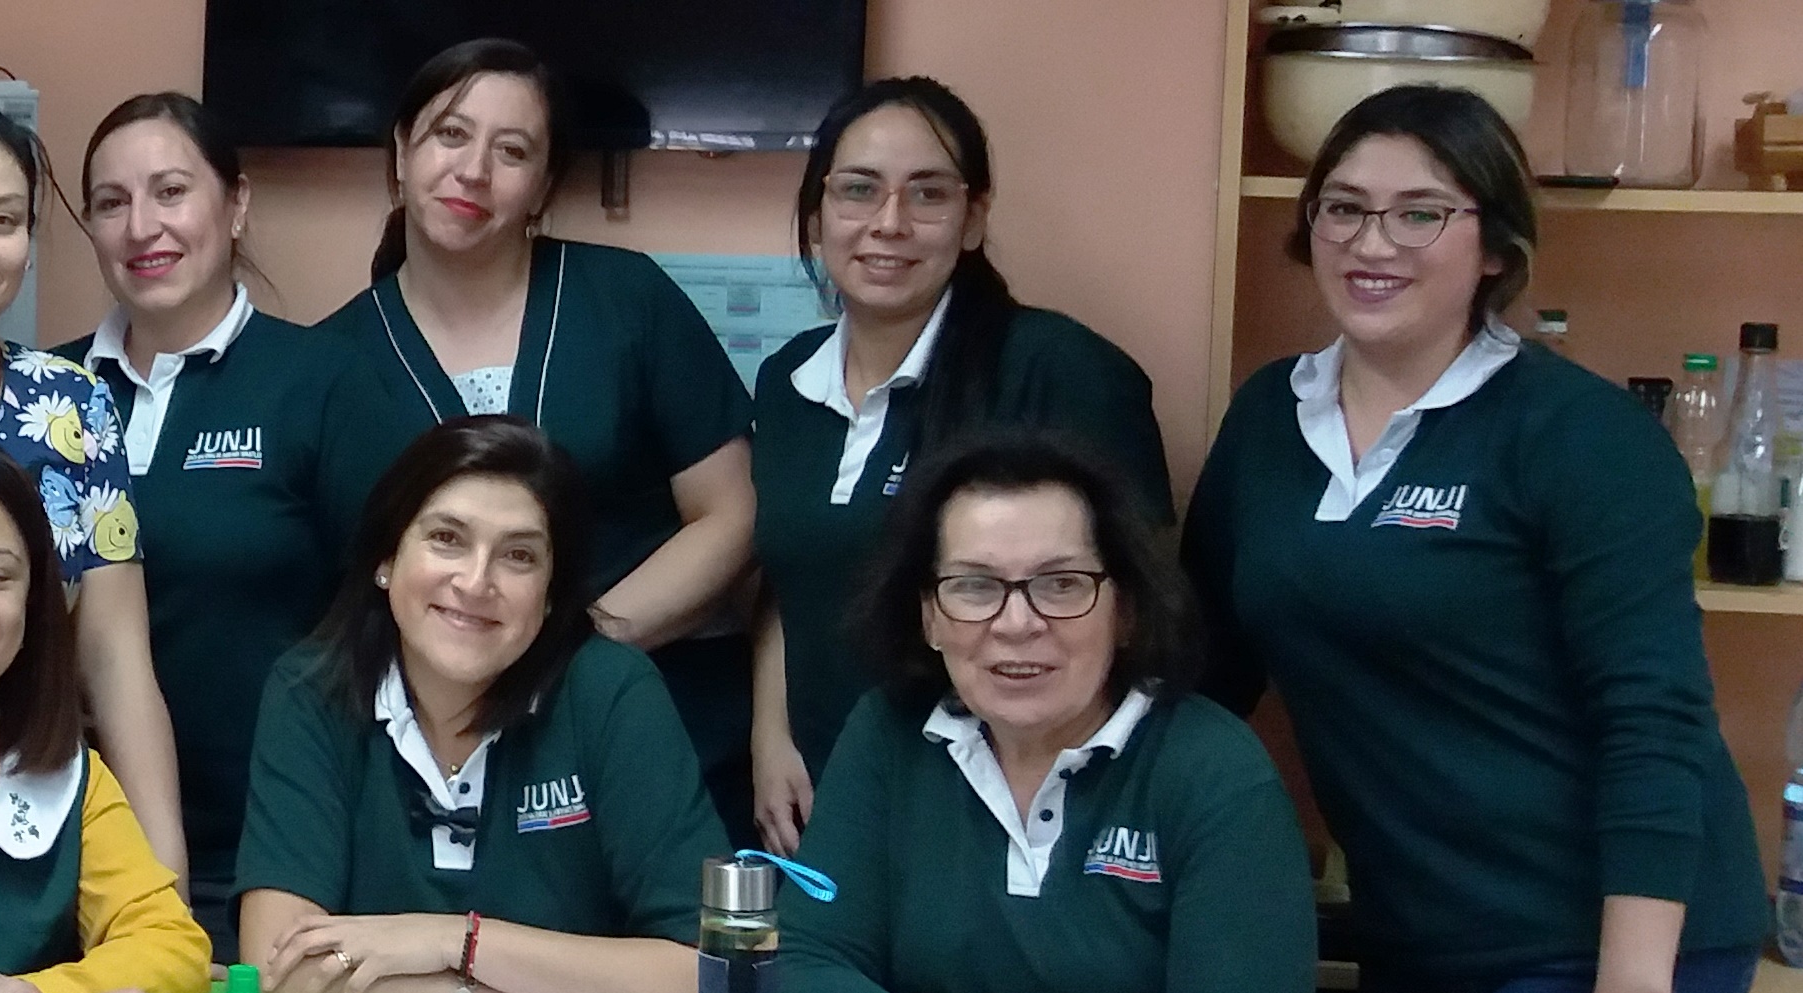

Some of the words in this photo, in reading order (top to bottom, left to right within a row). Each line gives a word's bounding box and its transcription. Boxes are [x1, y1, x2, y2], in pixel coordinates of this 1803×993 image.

[187, 427, 261, 455] JUNJI
[1381, 484, 1468, 511] JUNJI
[516, 774, 586, 813] JUNJ
